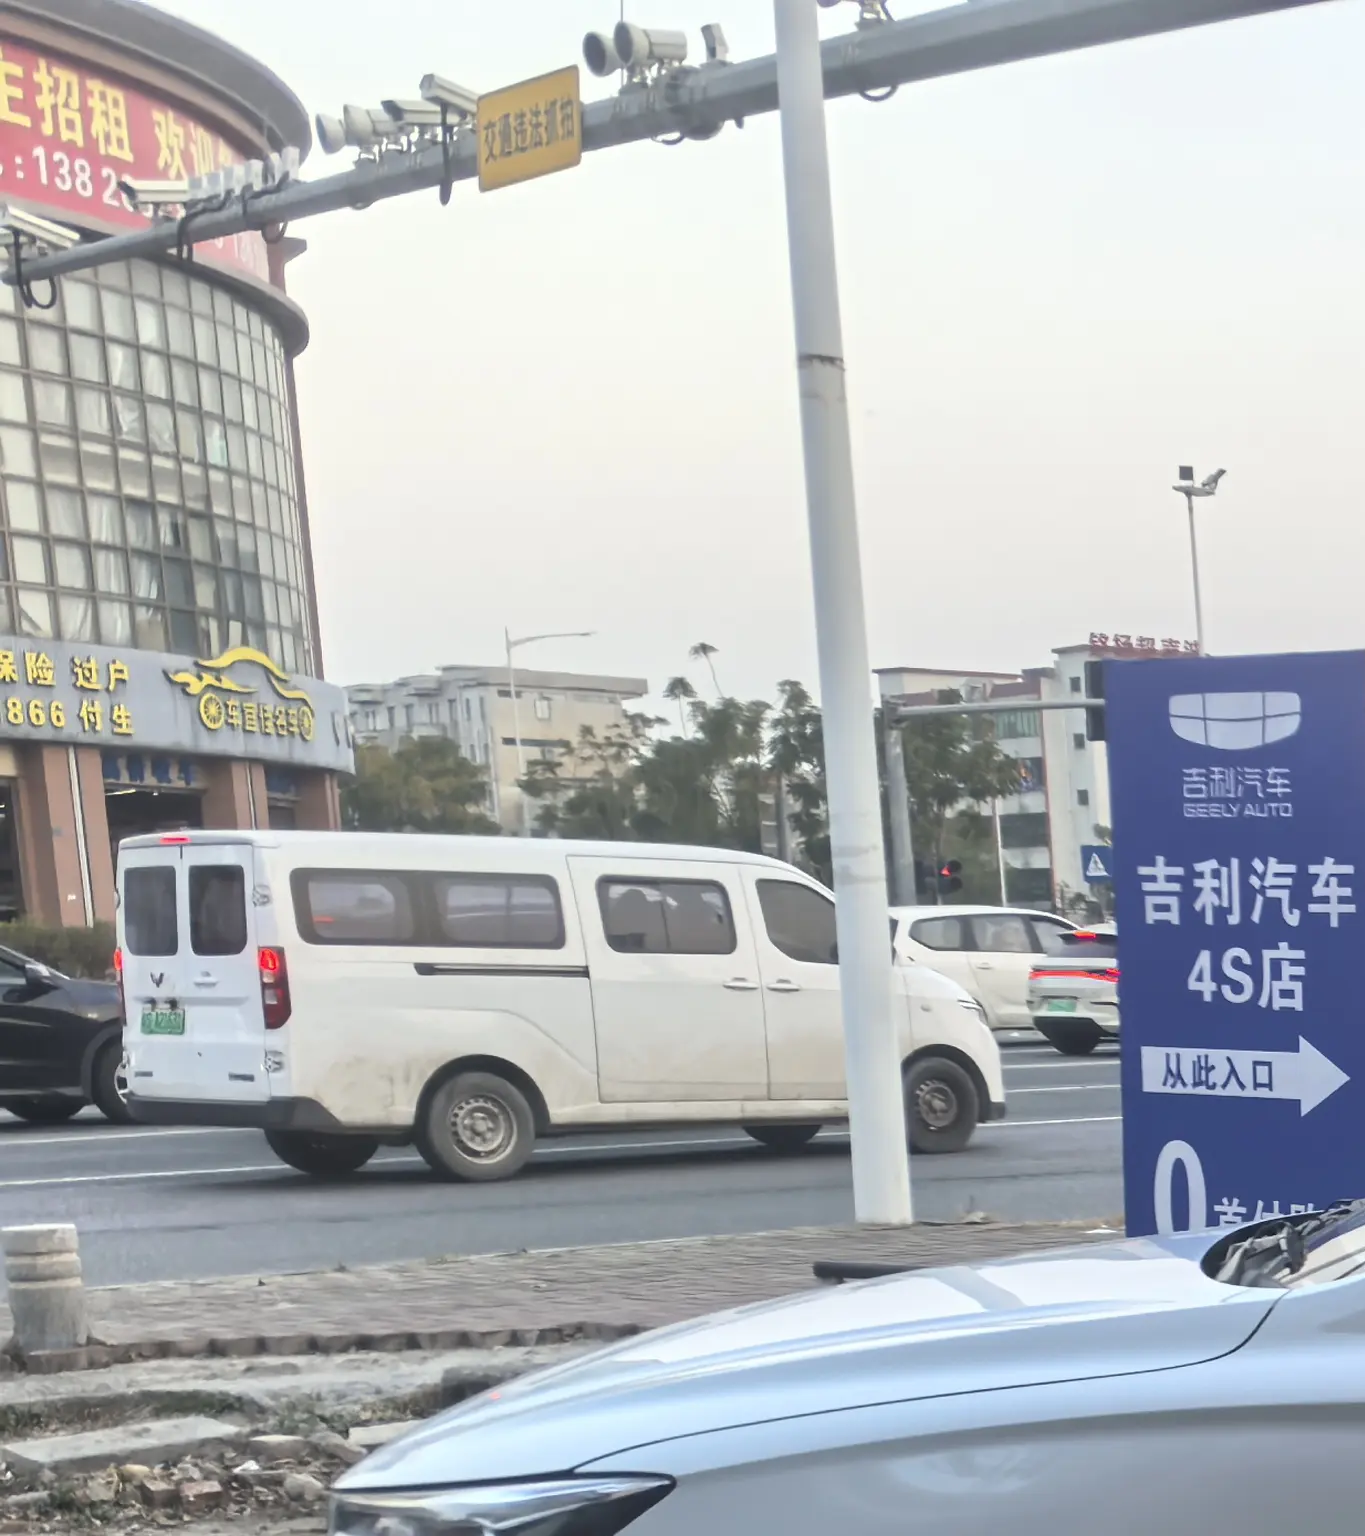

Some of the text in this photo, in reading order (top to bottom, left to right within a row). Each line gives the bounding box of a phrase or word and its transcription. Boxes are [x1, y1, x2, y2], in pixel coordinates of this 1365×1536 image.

[73, 655, 129, 692] 过户
[1182, 767, 1292, 798] 吉利汽车
[1183, 803, 1293, 818] GEELY AUTO
[1137, 855, 1357, 927] 吉利汽车
[1187, 942, 1306, 1011] 4S店
[1161, 1053, 1274, 1091] 从此入口
